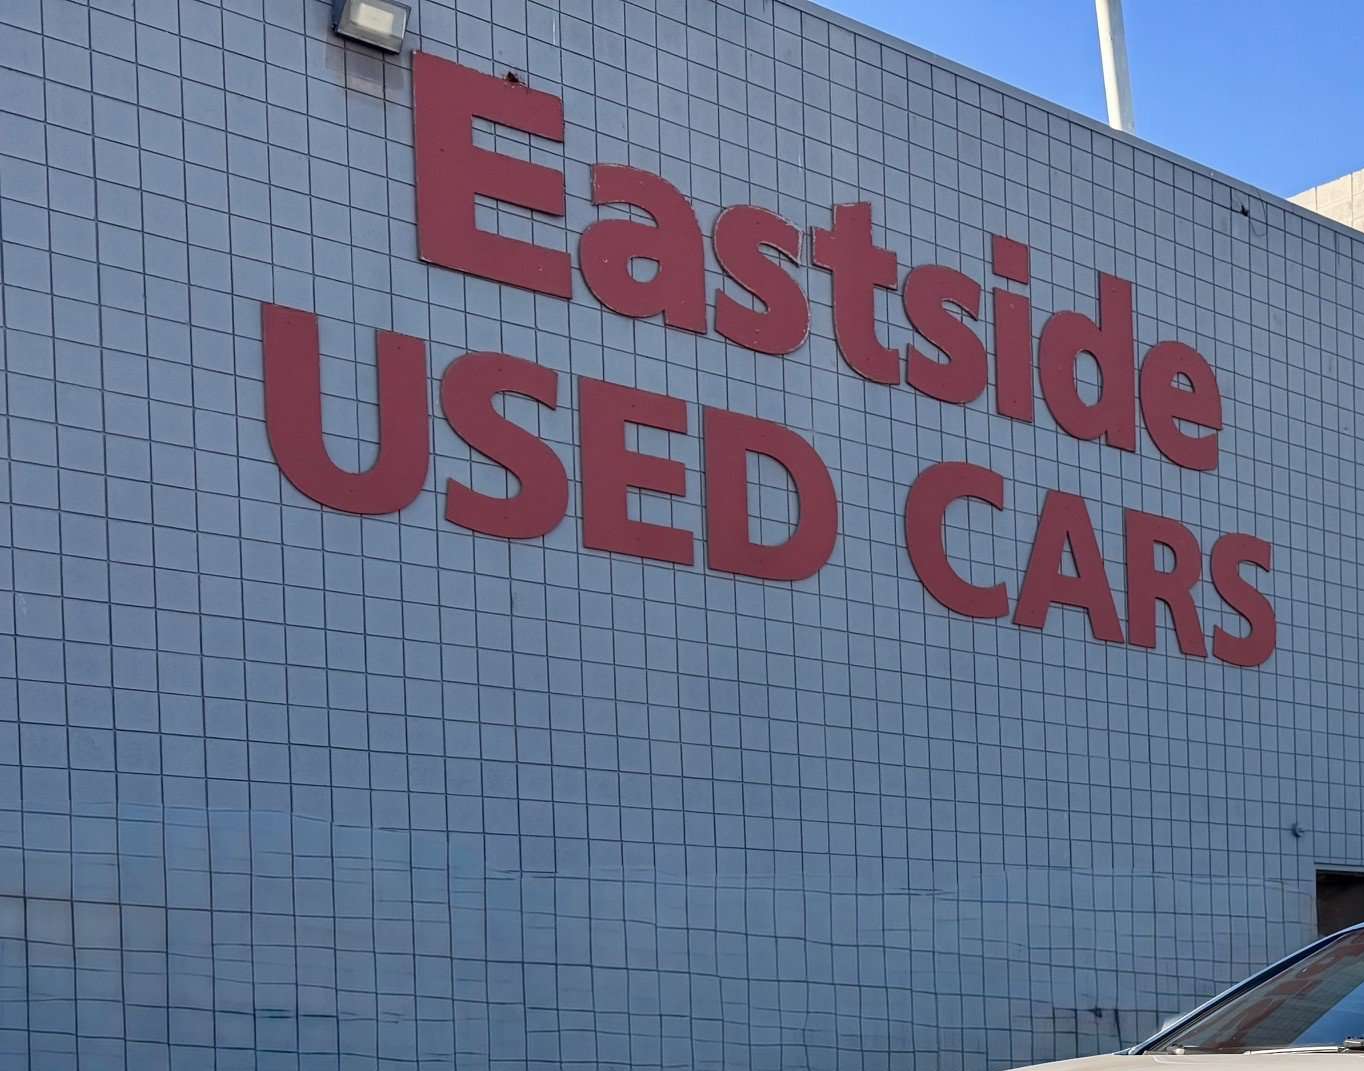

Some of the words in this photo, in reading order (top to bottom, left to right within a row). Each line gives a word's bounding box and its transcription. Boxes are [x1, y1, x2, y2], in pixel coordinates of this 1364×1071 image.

[411, 50, 1223, 471] Eastside
[261, 302, 839, 581] USED
[905, 461, 1278, 668] CARS
